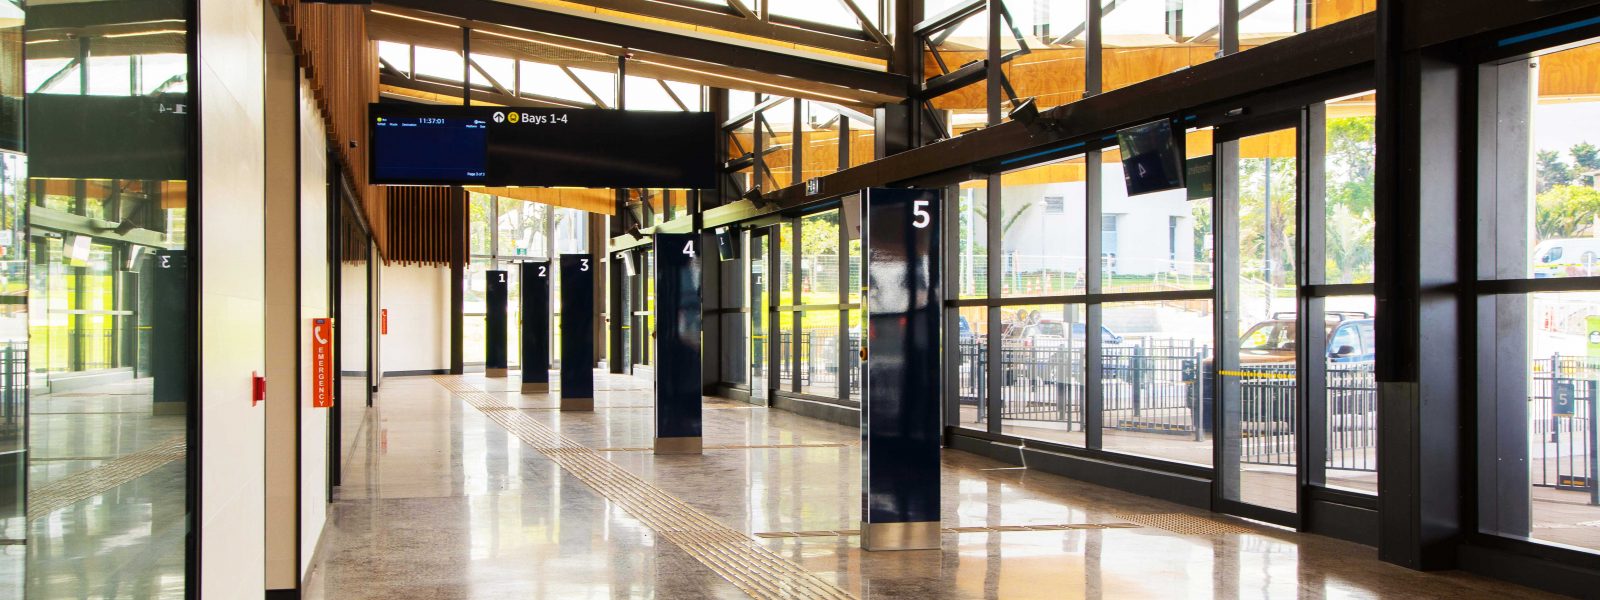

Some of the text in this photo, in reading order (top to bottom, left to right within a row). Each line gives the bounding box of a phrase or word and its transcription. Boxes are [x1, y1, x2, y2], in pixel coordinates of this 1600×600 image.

[419, 117, 445, 125] 11:37:01
[521, 112, 568, 125] Bays 1-4
[912, 200, 930, 229] 5
[682, 240, 696, 258] 4
[538, 265, 547, 277] 2
[580, 258, 589, 272] 3
[498, 273, 506, 283] 1
[317, 346, 325, 407] EMERGENCY
[1559, 393, 1568, 406] 5
